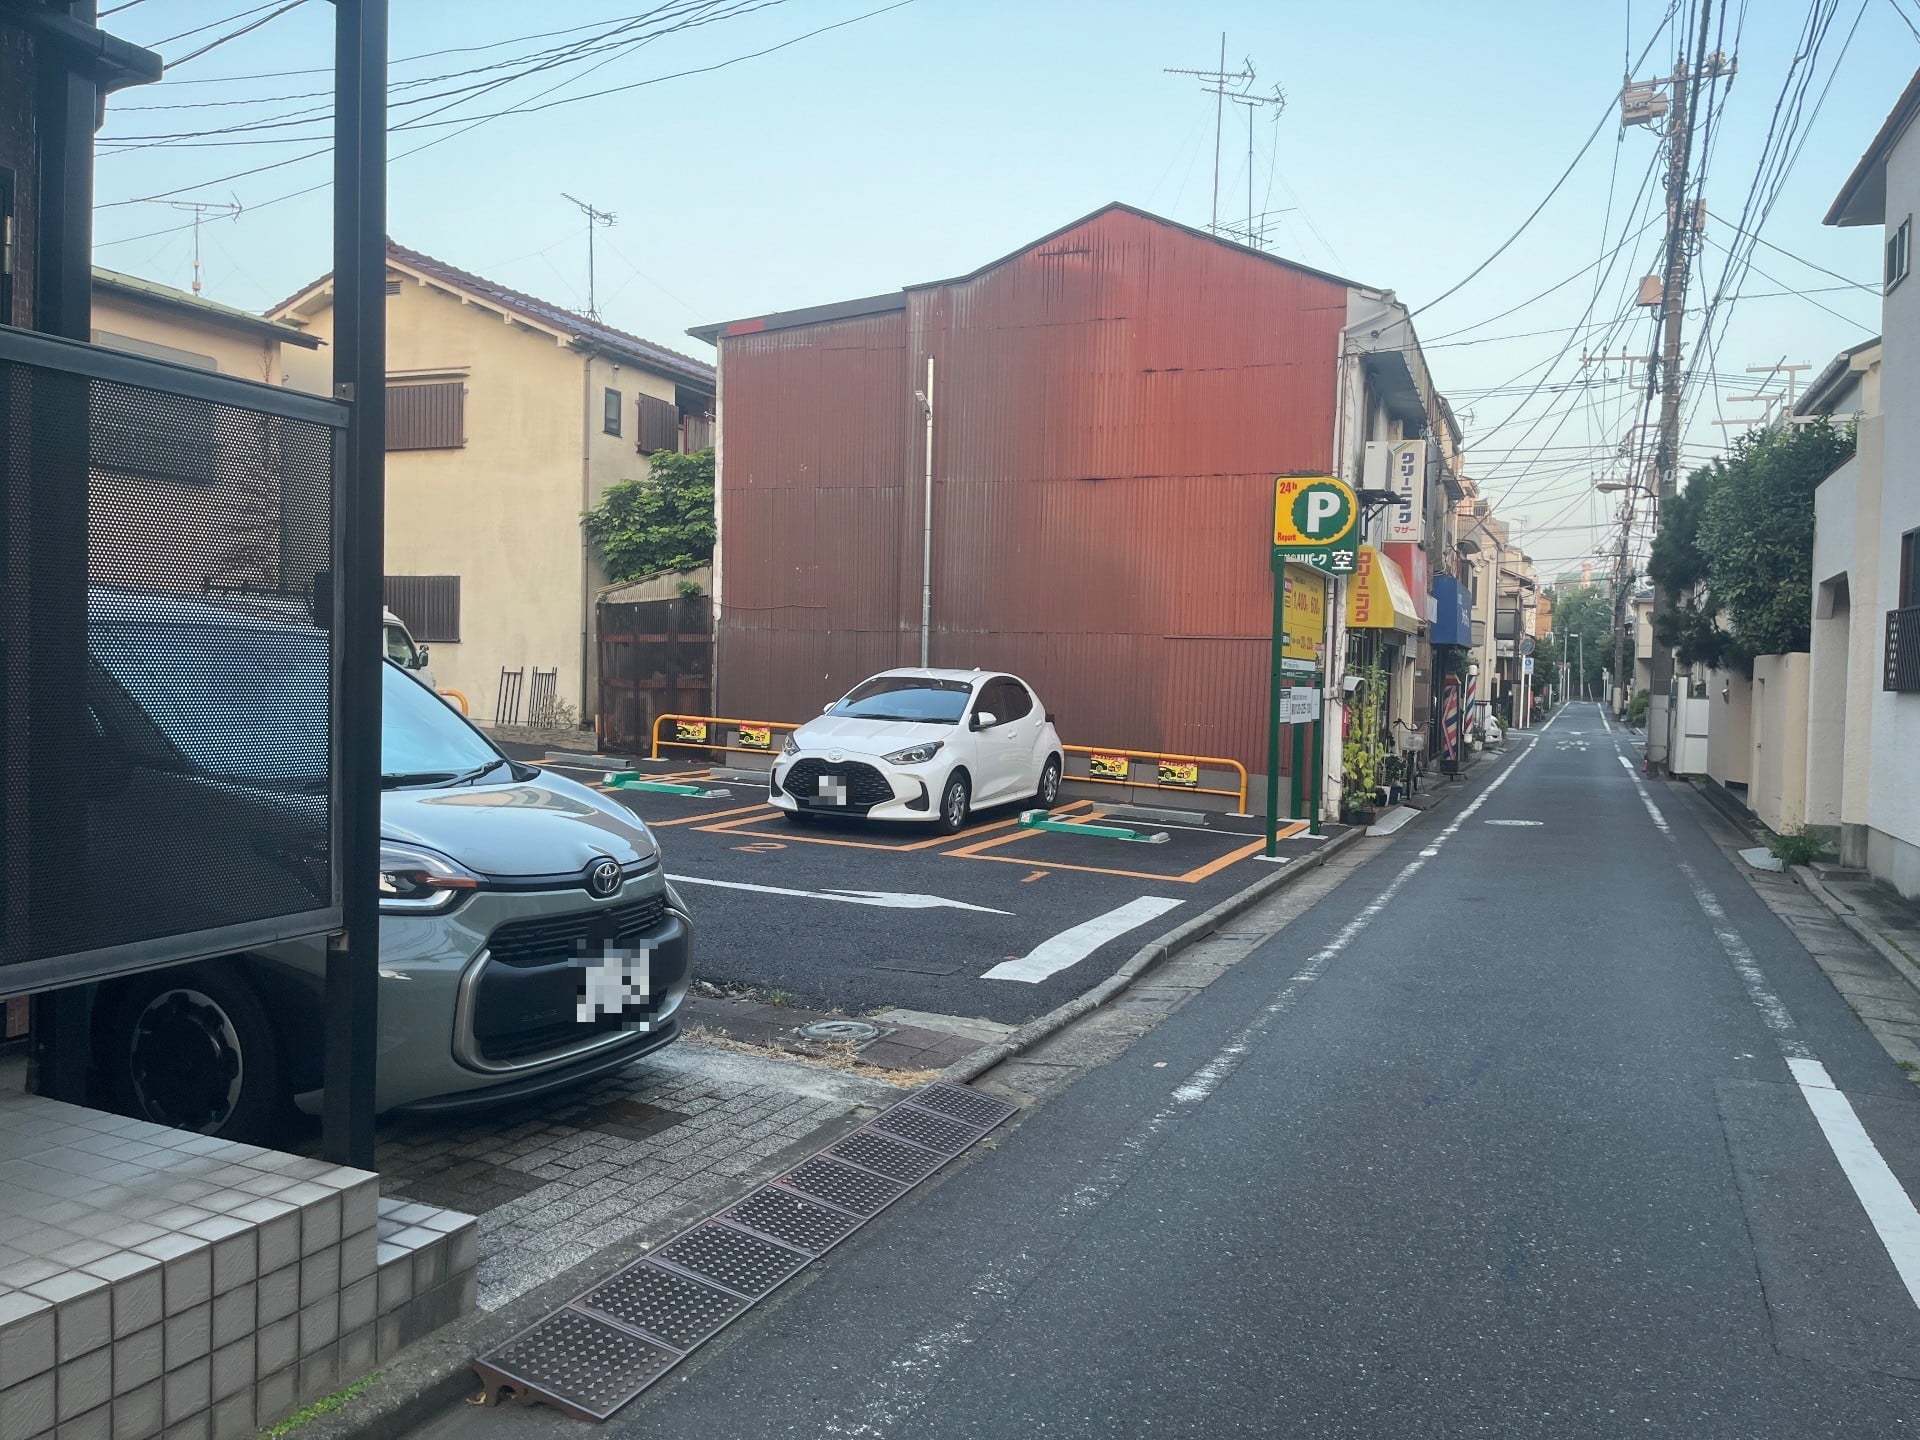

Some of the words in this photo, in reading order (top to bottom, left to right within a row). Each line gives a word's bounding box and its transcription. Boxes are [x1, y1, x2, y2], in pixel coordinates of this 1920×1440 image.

[1306, 491, 1341, 533] P
[1277, 531, 1297, 542] Repark
[1393, 526, 1417, 534] マザー
[1277, 552, 1328, 566] リパーク
[1331, 549, 1354, 570] 空
